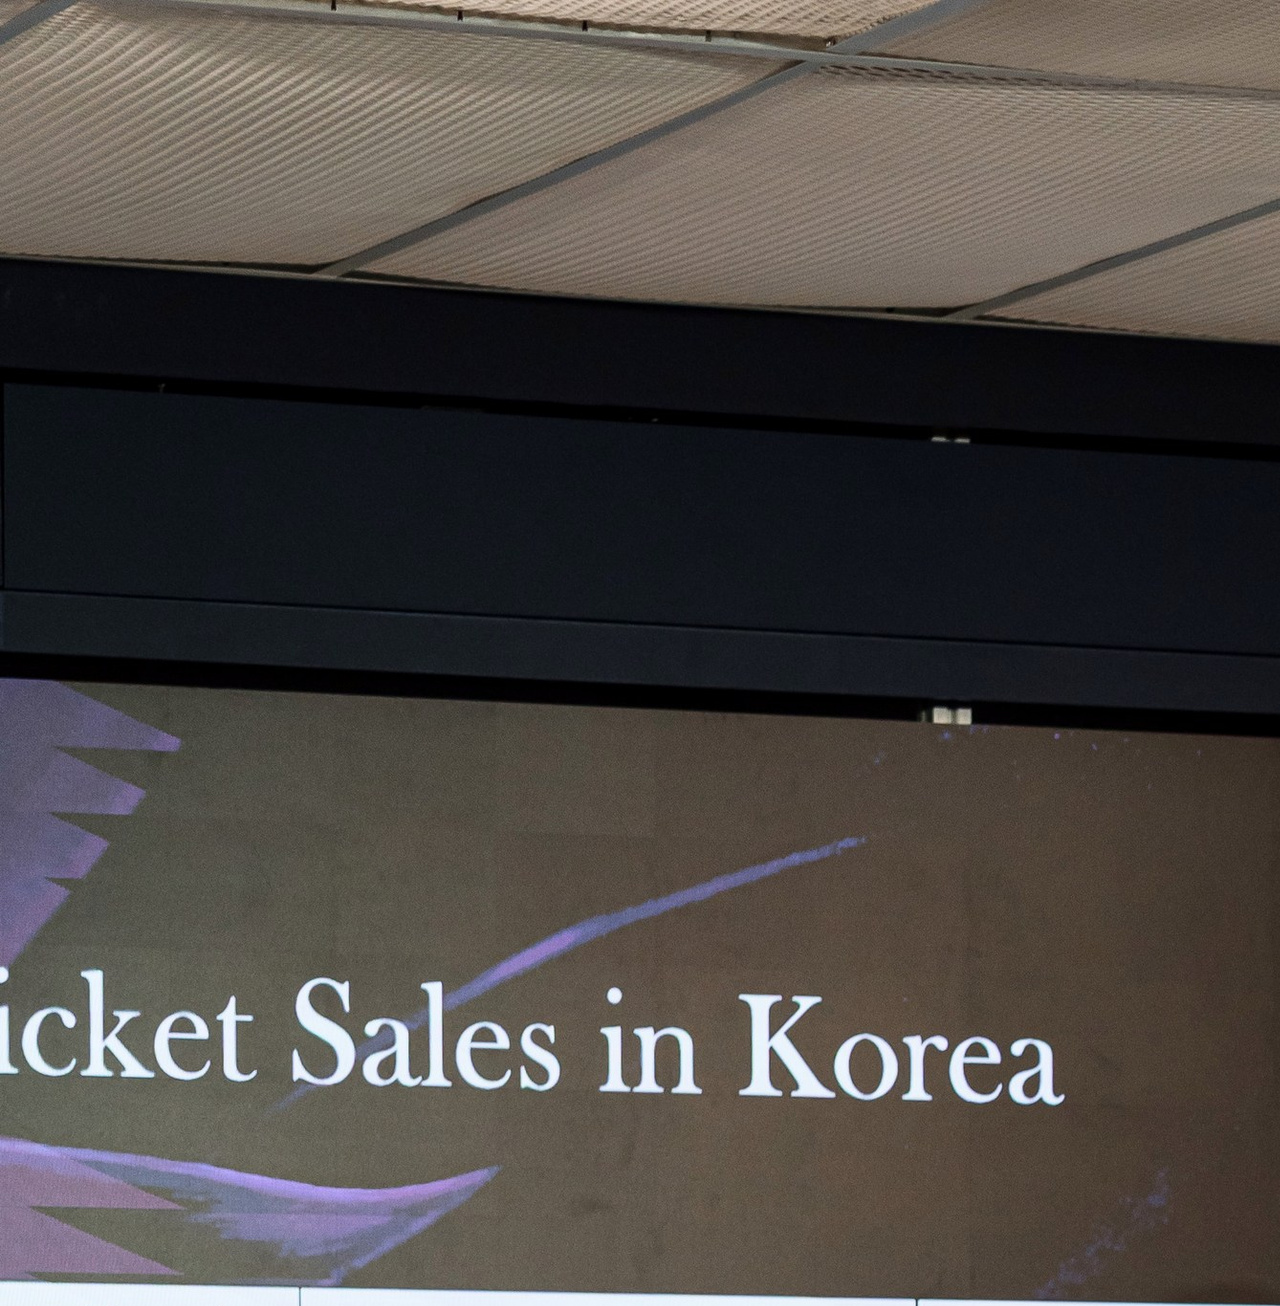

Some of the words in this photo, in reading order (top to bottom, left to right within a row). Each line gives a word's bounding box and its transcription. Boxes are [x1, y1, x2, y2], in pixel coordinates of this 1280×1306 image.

[293, 978, 560, 1091] Sales
[599, 987, 702, 1094] in
[739, 994, 1065, 1105] Korea
